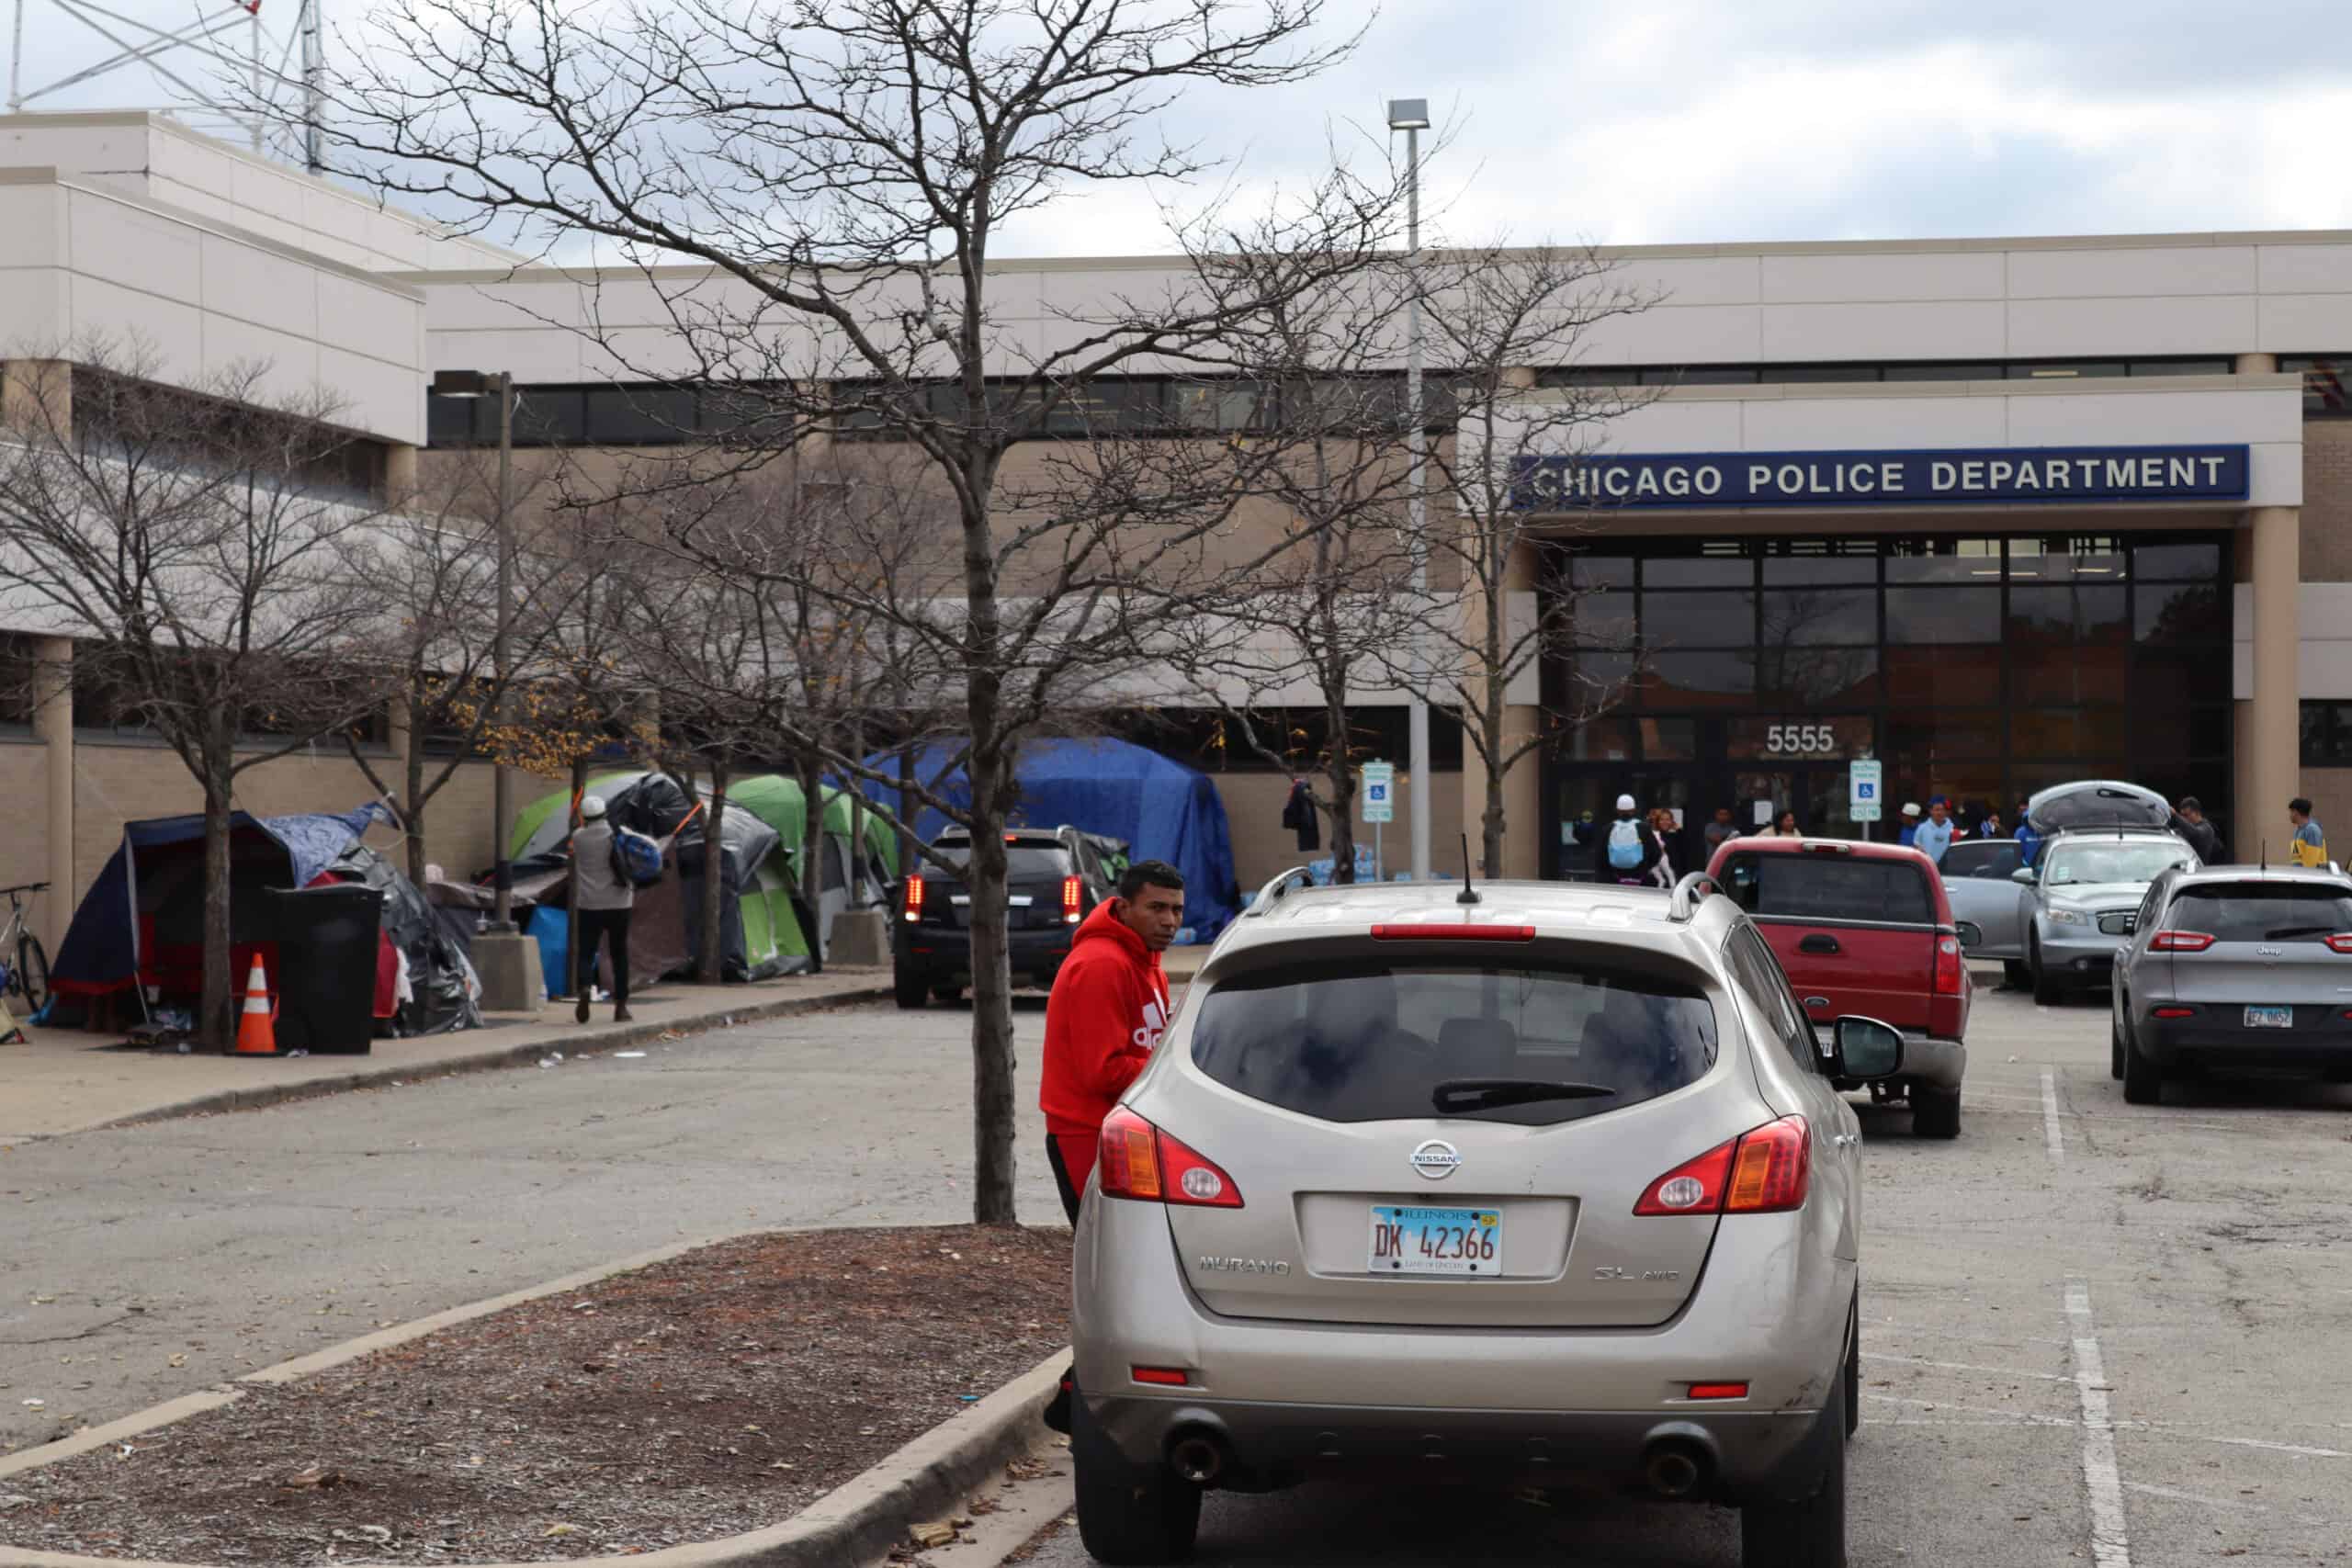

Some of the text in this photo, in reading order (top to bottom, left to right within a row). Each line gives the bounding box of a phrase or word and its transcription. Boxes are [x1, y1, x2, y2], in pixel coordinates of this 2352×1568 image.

[1533, 457, 2226, 497] CHICAGO POLICE DEPARTMENT
[1766, 725, 1835, 752] 5555
[1404, 1210, 1469, 1221] ILLINOIS
[1374, 1224, 1494, 1260] DK 42366
[1198, 1256, 1292, 1277] MURANO
[1594, 1266, 1635, 1280] SL
